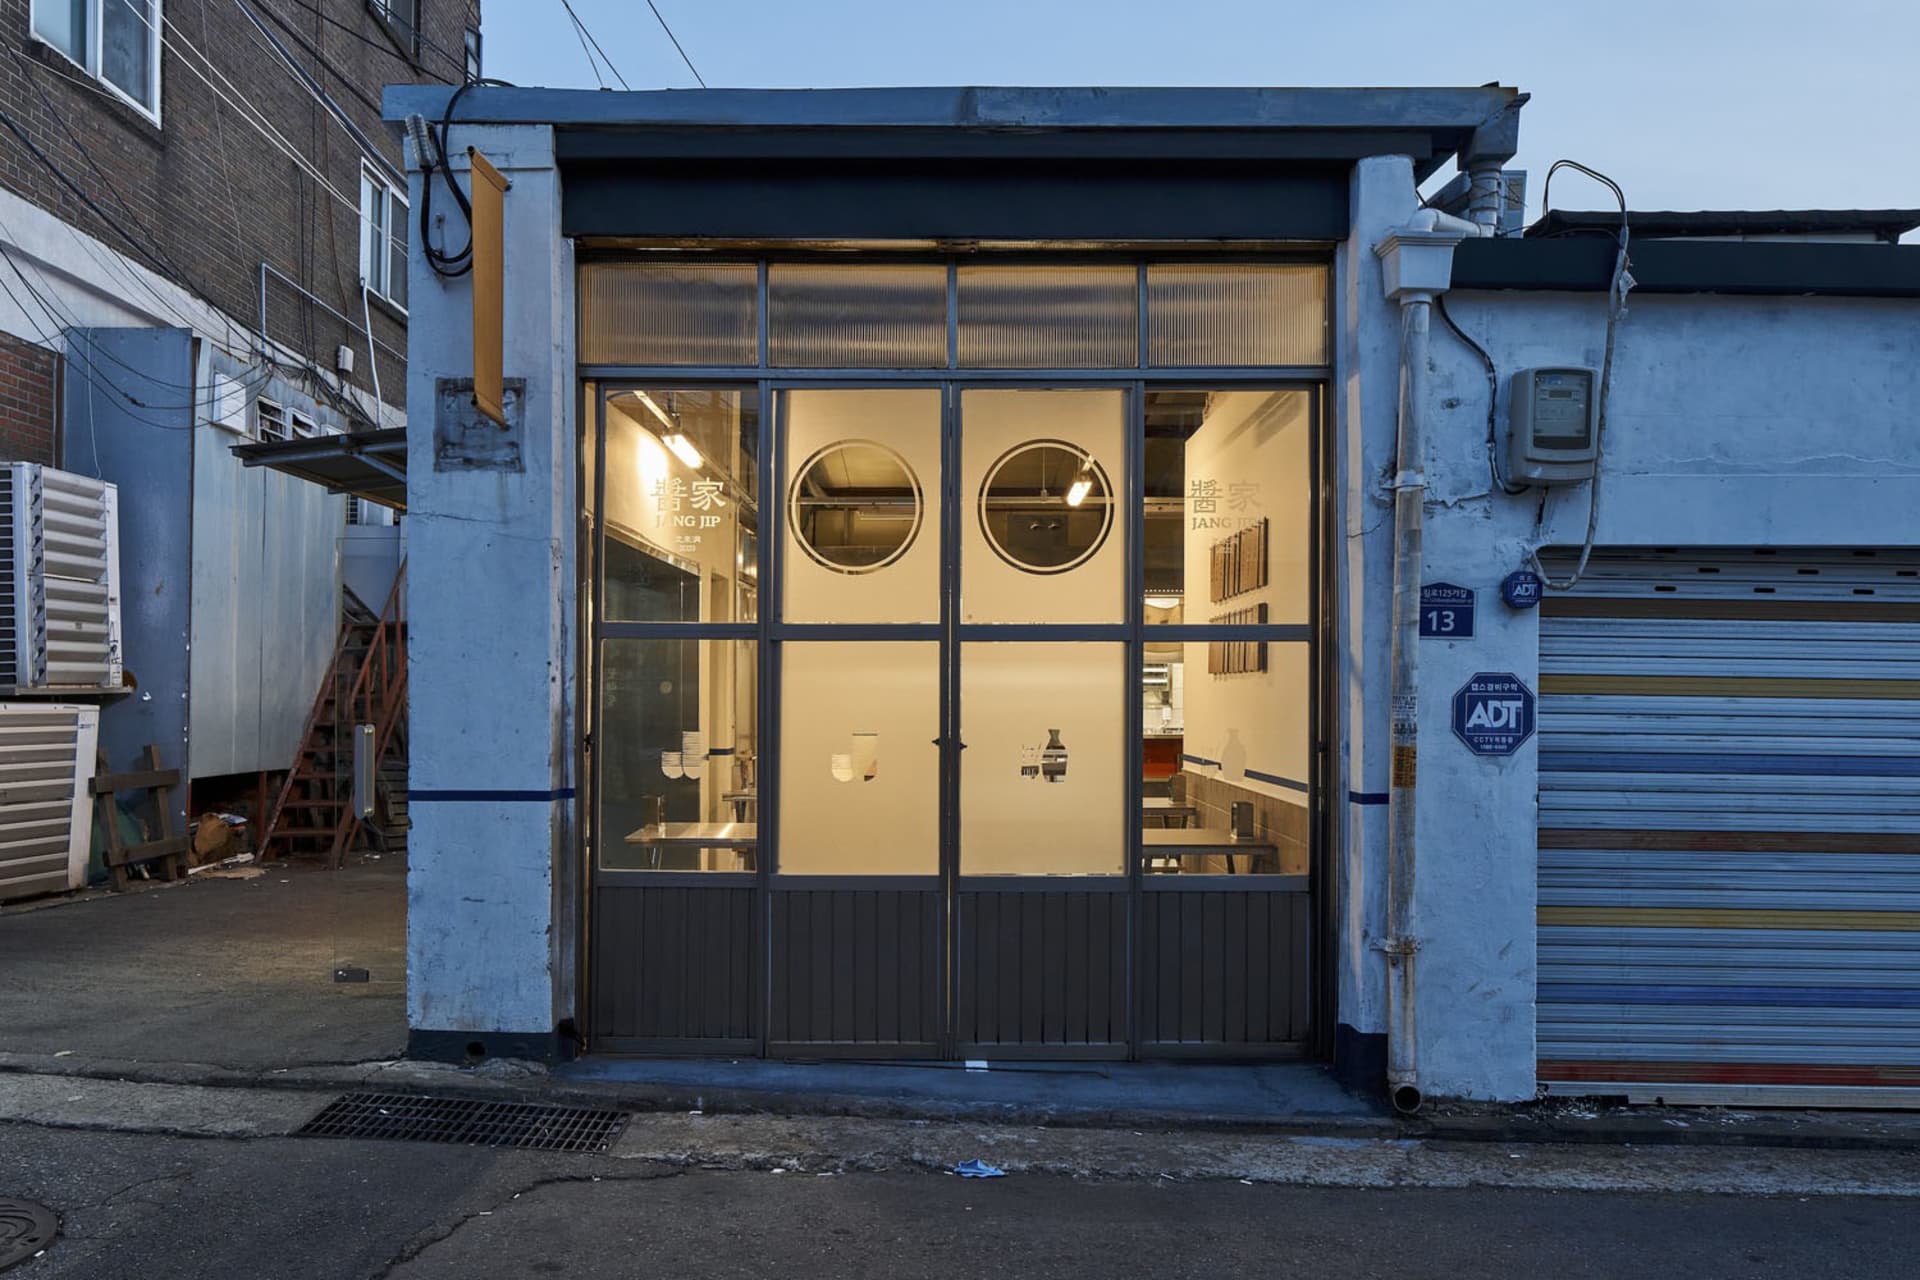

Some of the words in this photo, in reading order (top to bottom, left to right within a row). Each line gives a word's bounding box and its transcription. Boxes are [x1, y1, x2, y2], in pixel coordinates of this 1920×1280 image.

[699, 515, 721, 529] JIP
[1192, 517, 1232, 530] JANG
[1513, 583, 1537, 597] ADT
[1427, 610, 1456, 632] 13
[1466, 700, 1523, 729] ADT
